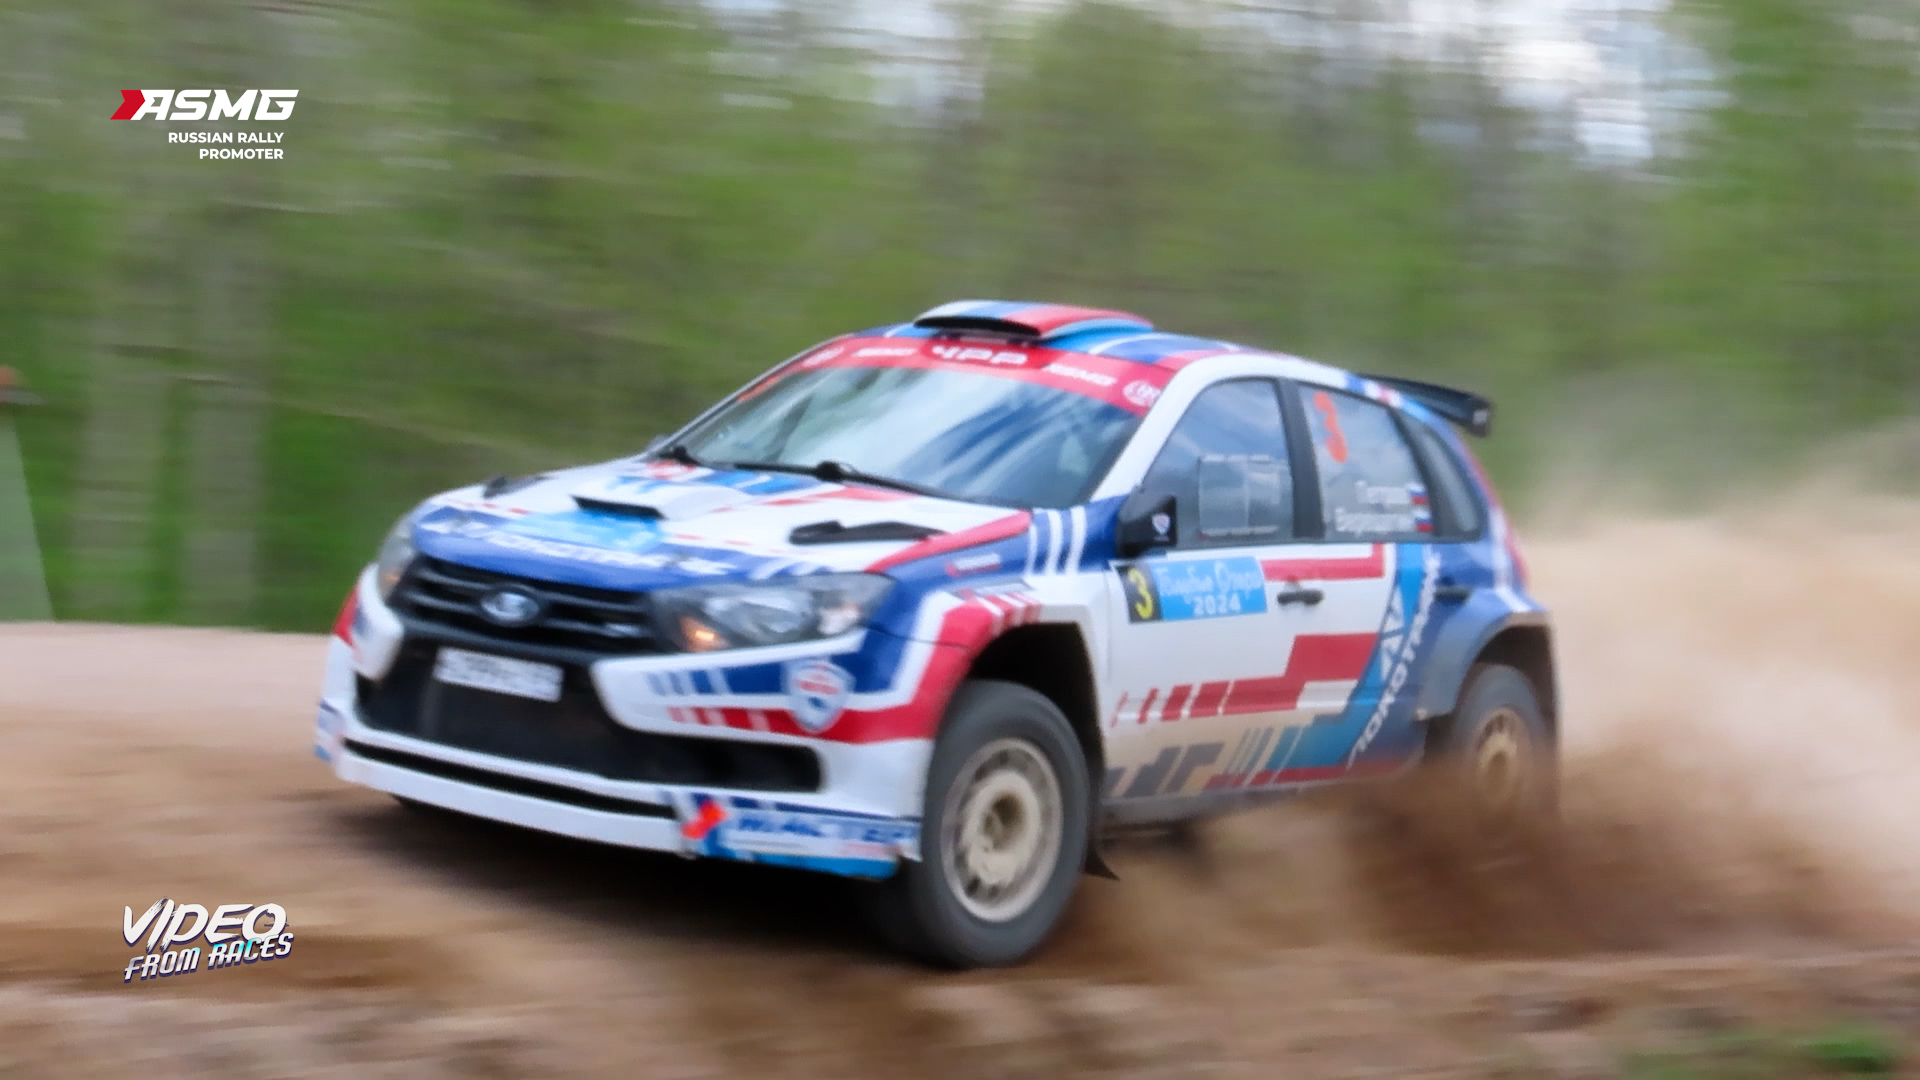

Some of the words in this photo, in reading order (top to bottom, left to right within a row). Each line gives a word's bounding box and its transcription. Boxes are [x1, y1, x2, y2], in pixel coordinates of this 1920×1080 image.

[1314, 391, 1348, 463] 3
[1127, 567, 1153, 619] 3
[1192, 593, 1241, 616] 2024
